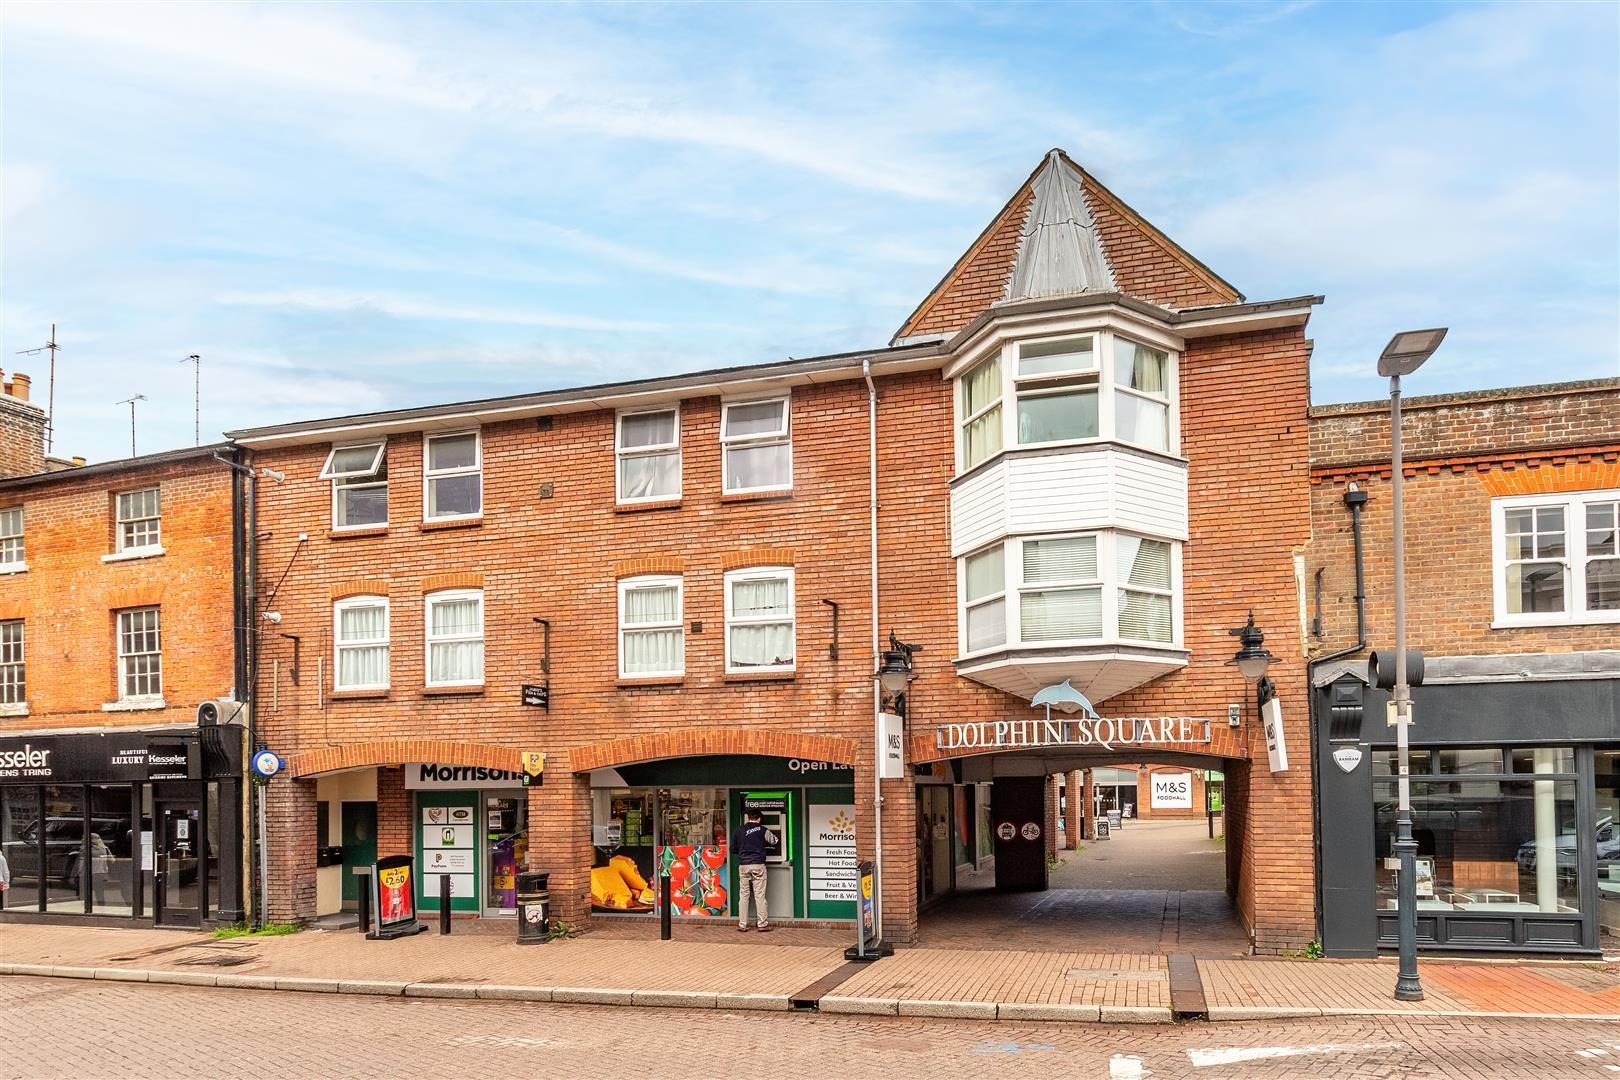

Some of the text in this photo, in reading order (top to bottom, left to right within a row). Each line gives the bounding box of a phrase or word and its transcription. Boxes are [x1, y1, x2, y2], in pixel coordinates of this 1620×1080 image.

[948, 717, 1195, 751] DOLPHIN SQUARE
[112, 755, 144, 765] LUXURY
[148, 754, 187, 763] Kesseler
[788, 758, 828, 775] Open
[22, 768, 52, 776] TRING
[1156, 782, 1187, 793] M&S
[745, 800, 759, 808] free
[819, 833, 855, 841] Morriso
